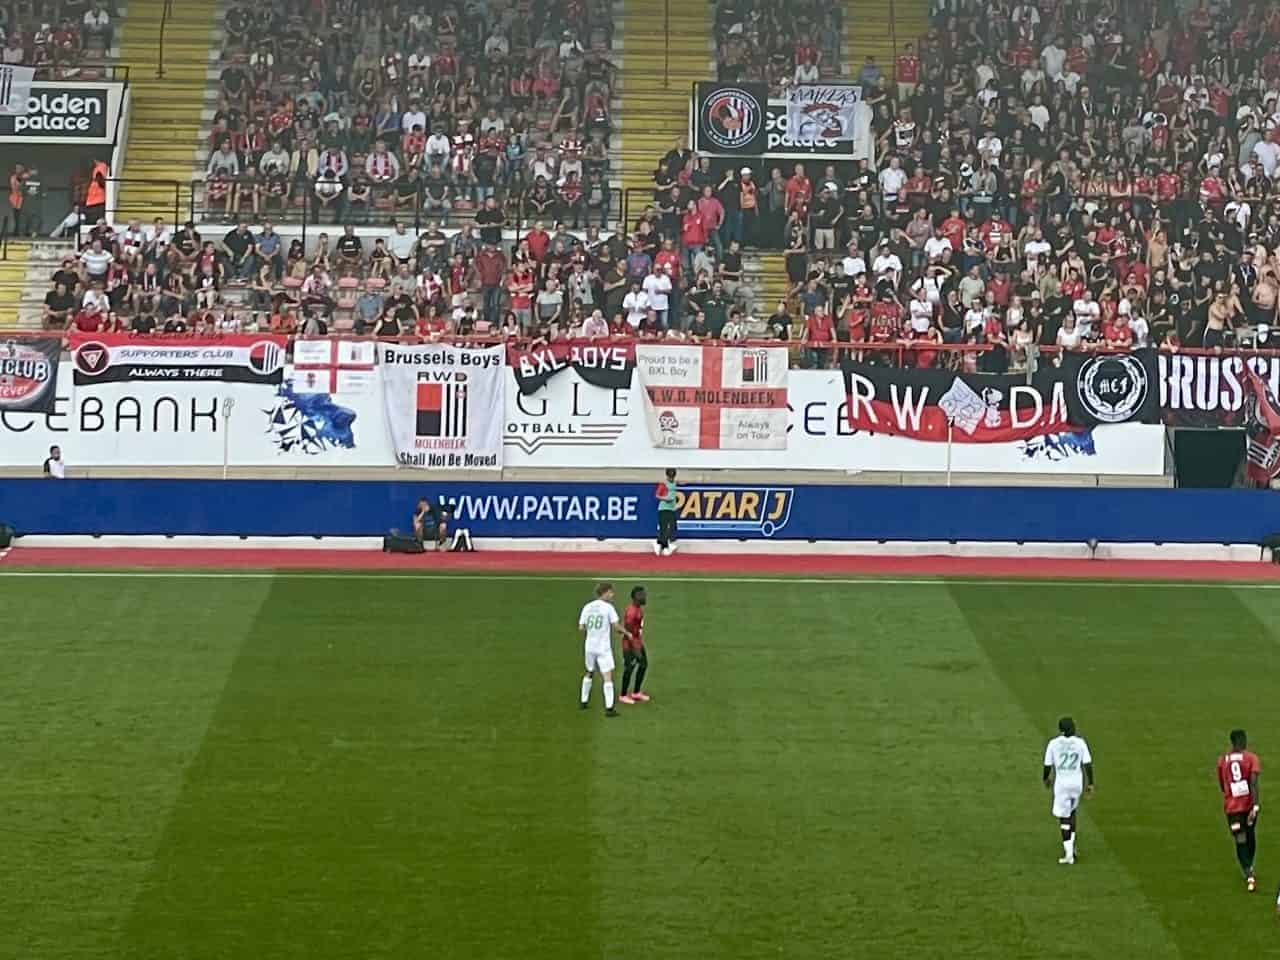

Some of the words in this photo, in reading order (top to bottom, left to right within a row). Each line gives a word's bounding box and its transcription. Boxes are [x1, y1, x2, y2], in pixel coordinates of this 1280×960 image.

[27, 93, 101, 114] olden
[15, 114, 91, 133] palace
[120, 350, 199, 359] SUPPORTERS
[201, 350, 234, 359] CLUB
[384, 349, 455, 365] Brussels
[461, 352, 500, 369] Boys
[638, 354, 666, 365] Proud
[668, 354, 677, 365] to
[678, 355, 690, 365] be
[520, 348, 566, 378] BXL
[128, 368, 180, 377] ALWAYS
[183, 368, 224, 377] THERE
[417, 371, 468, 382] RWD
[670, 367, 688, 378] Boy
[694, 390, 776, 406] MOLENBEEK
[736, 432, 749, 440] on
[751, 431, 771, 440] Tour
[415, 439, 466, 449] MOLENBEEK
[399, 452, 426, 466] Shall
[428, 453, 446, 467] Not
[448, 453, 462, 466] Be
[464, 453, 497, 467] Moved
[1058, 753, 1080, 771] 22
[1230, 760, 1242, 782] 9
